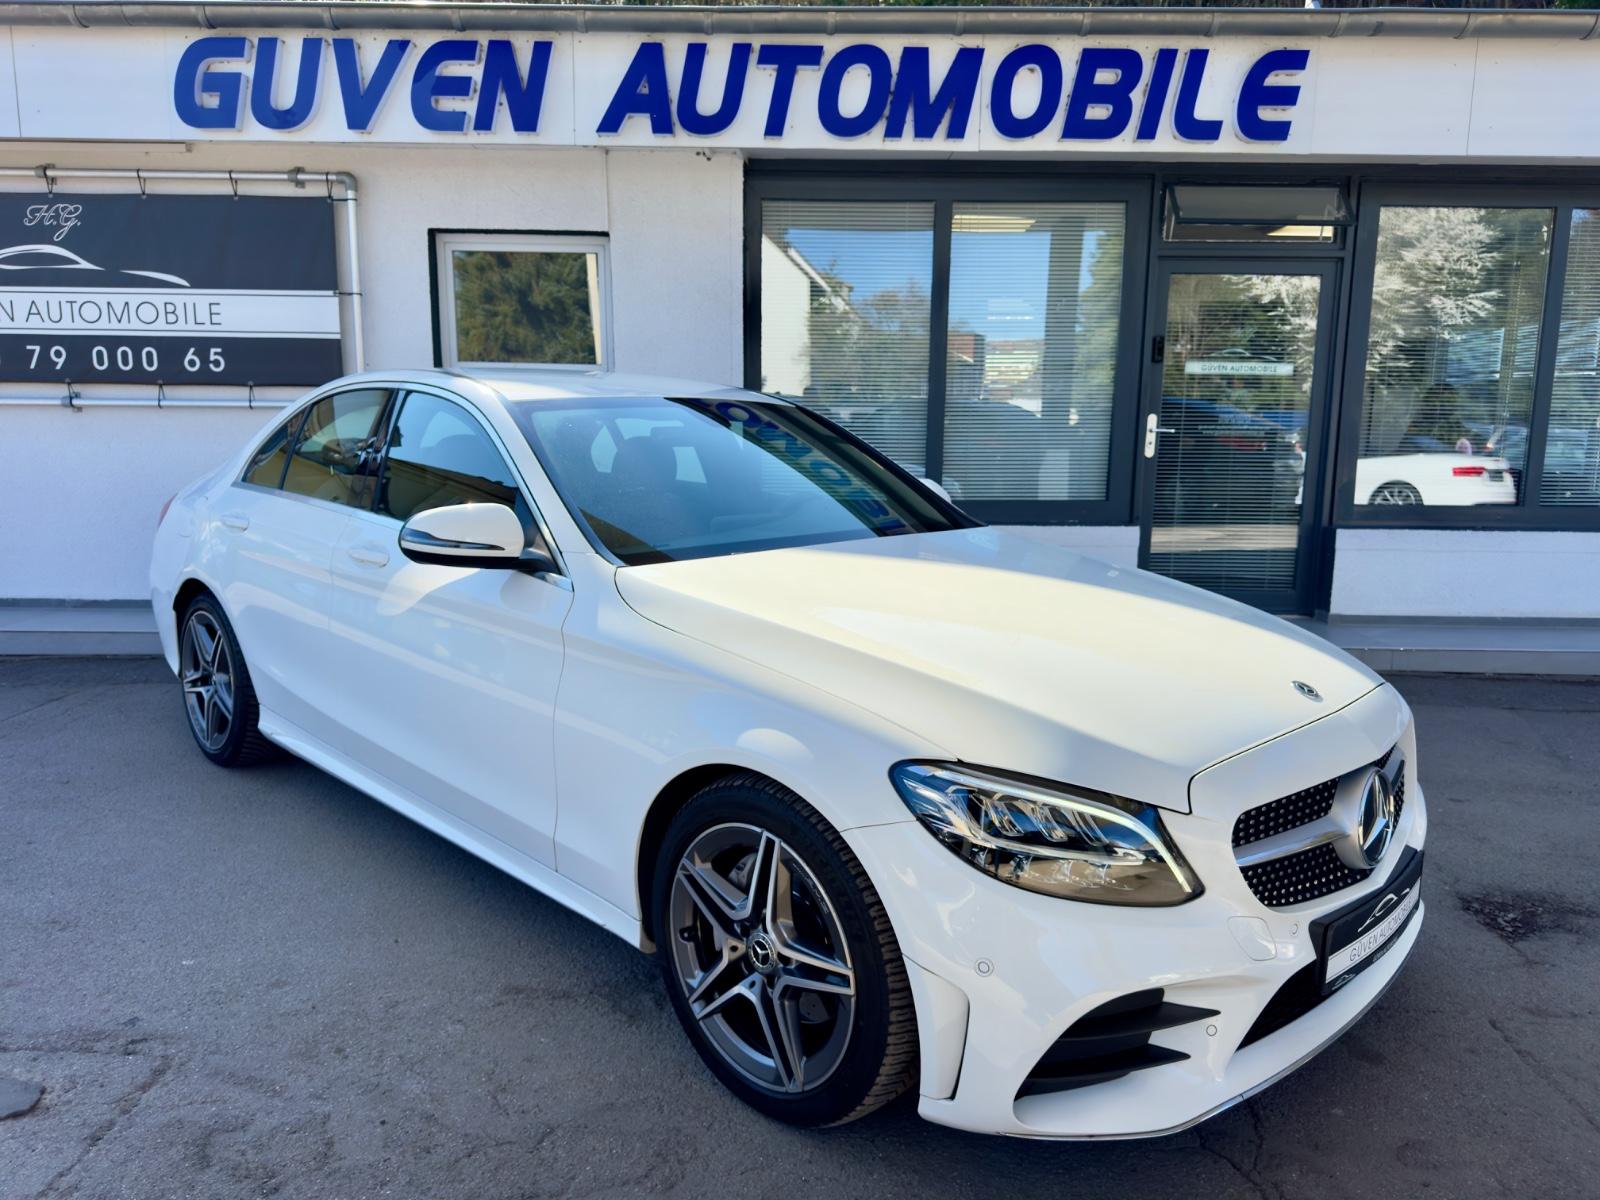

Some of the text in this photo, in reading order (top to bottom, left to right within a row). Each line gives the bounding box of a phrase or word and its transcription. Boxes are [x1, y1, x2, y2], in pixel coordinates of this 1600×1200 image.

[174, 37, 1310, 141] GUVEN AUTOMOBILE
[25, 299, 223, 326] AUTOMOBILE
[26, 345, 225, 372] 79 000 65
